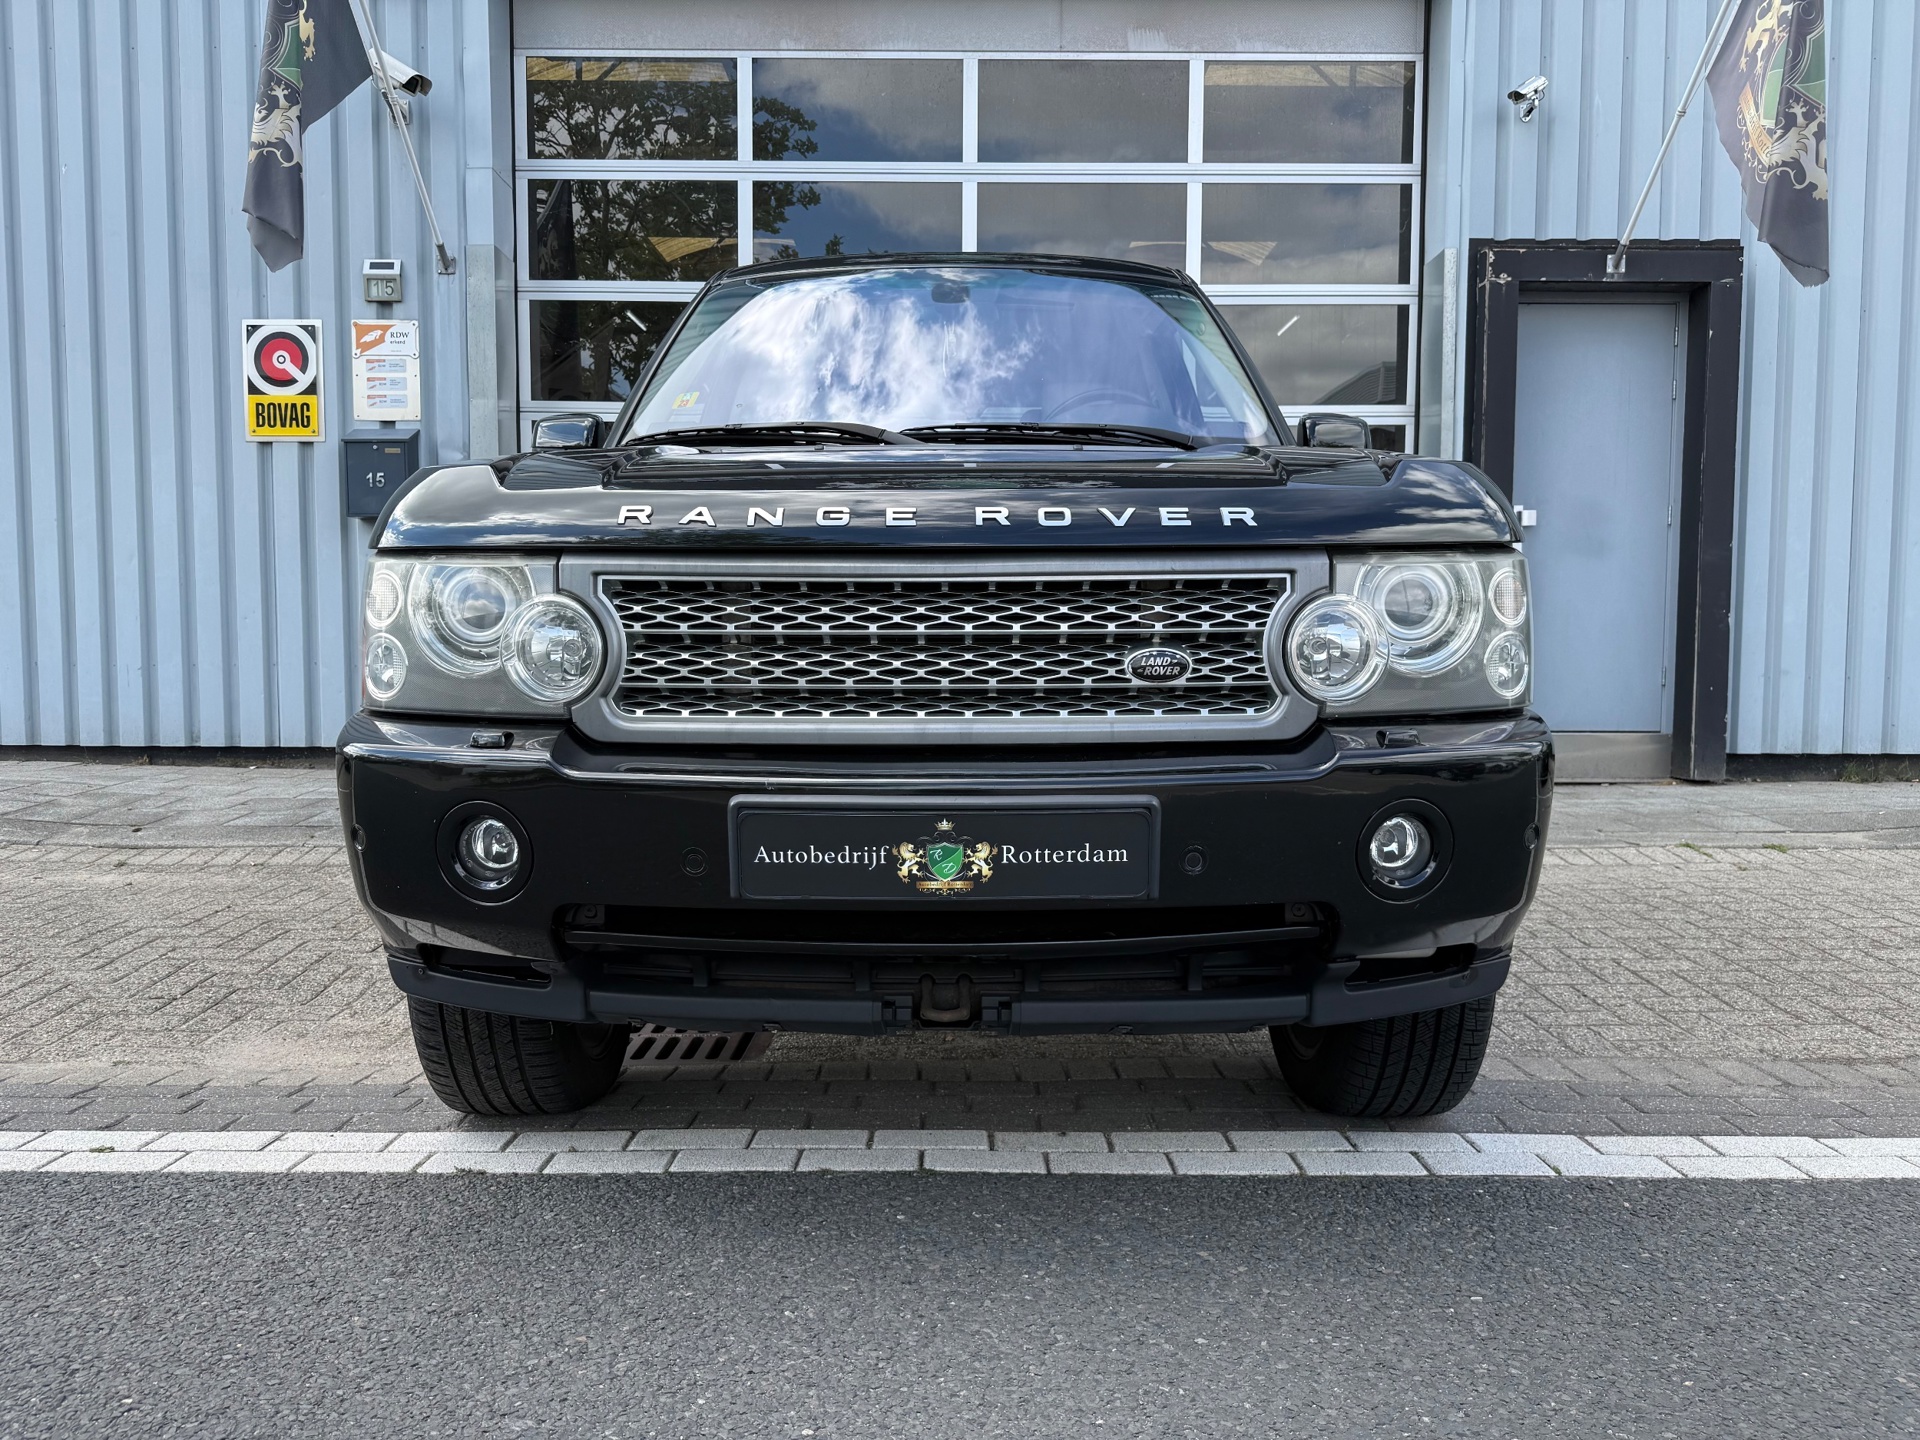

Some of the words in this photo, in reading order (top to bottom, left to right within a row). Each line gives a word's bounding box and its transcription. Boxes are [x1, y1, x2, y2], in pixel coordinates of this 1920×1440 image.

[373, 280, 394, 296] 15
[390, 331, 409, 339] RDW
[255, 402, 311, 429] BOVAG
[366, 472, 385, 488] 15
[617, 505, 918, 528] RANGE
[974, 506, 1258, 527] ROVER
[1143, 667, 1180, 675] ROVER
[754, 845, 889, 871] Autobedrijf
[1001, 843, 1129, 864] Rotterdam
